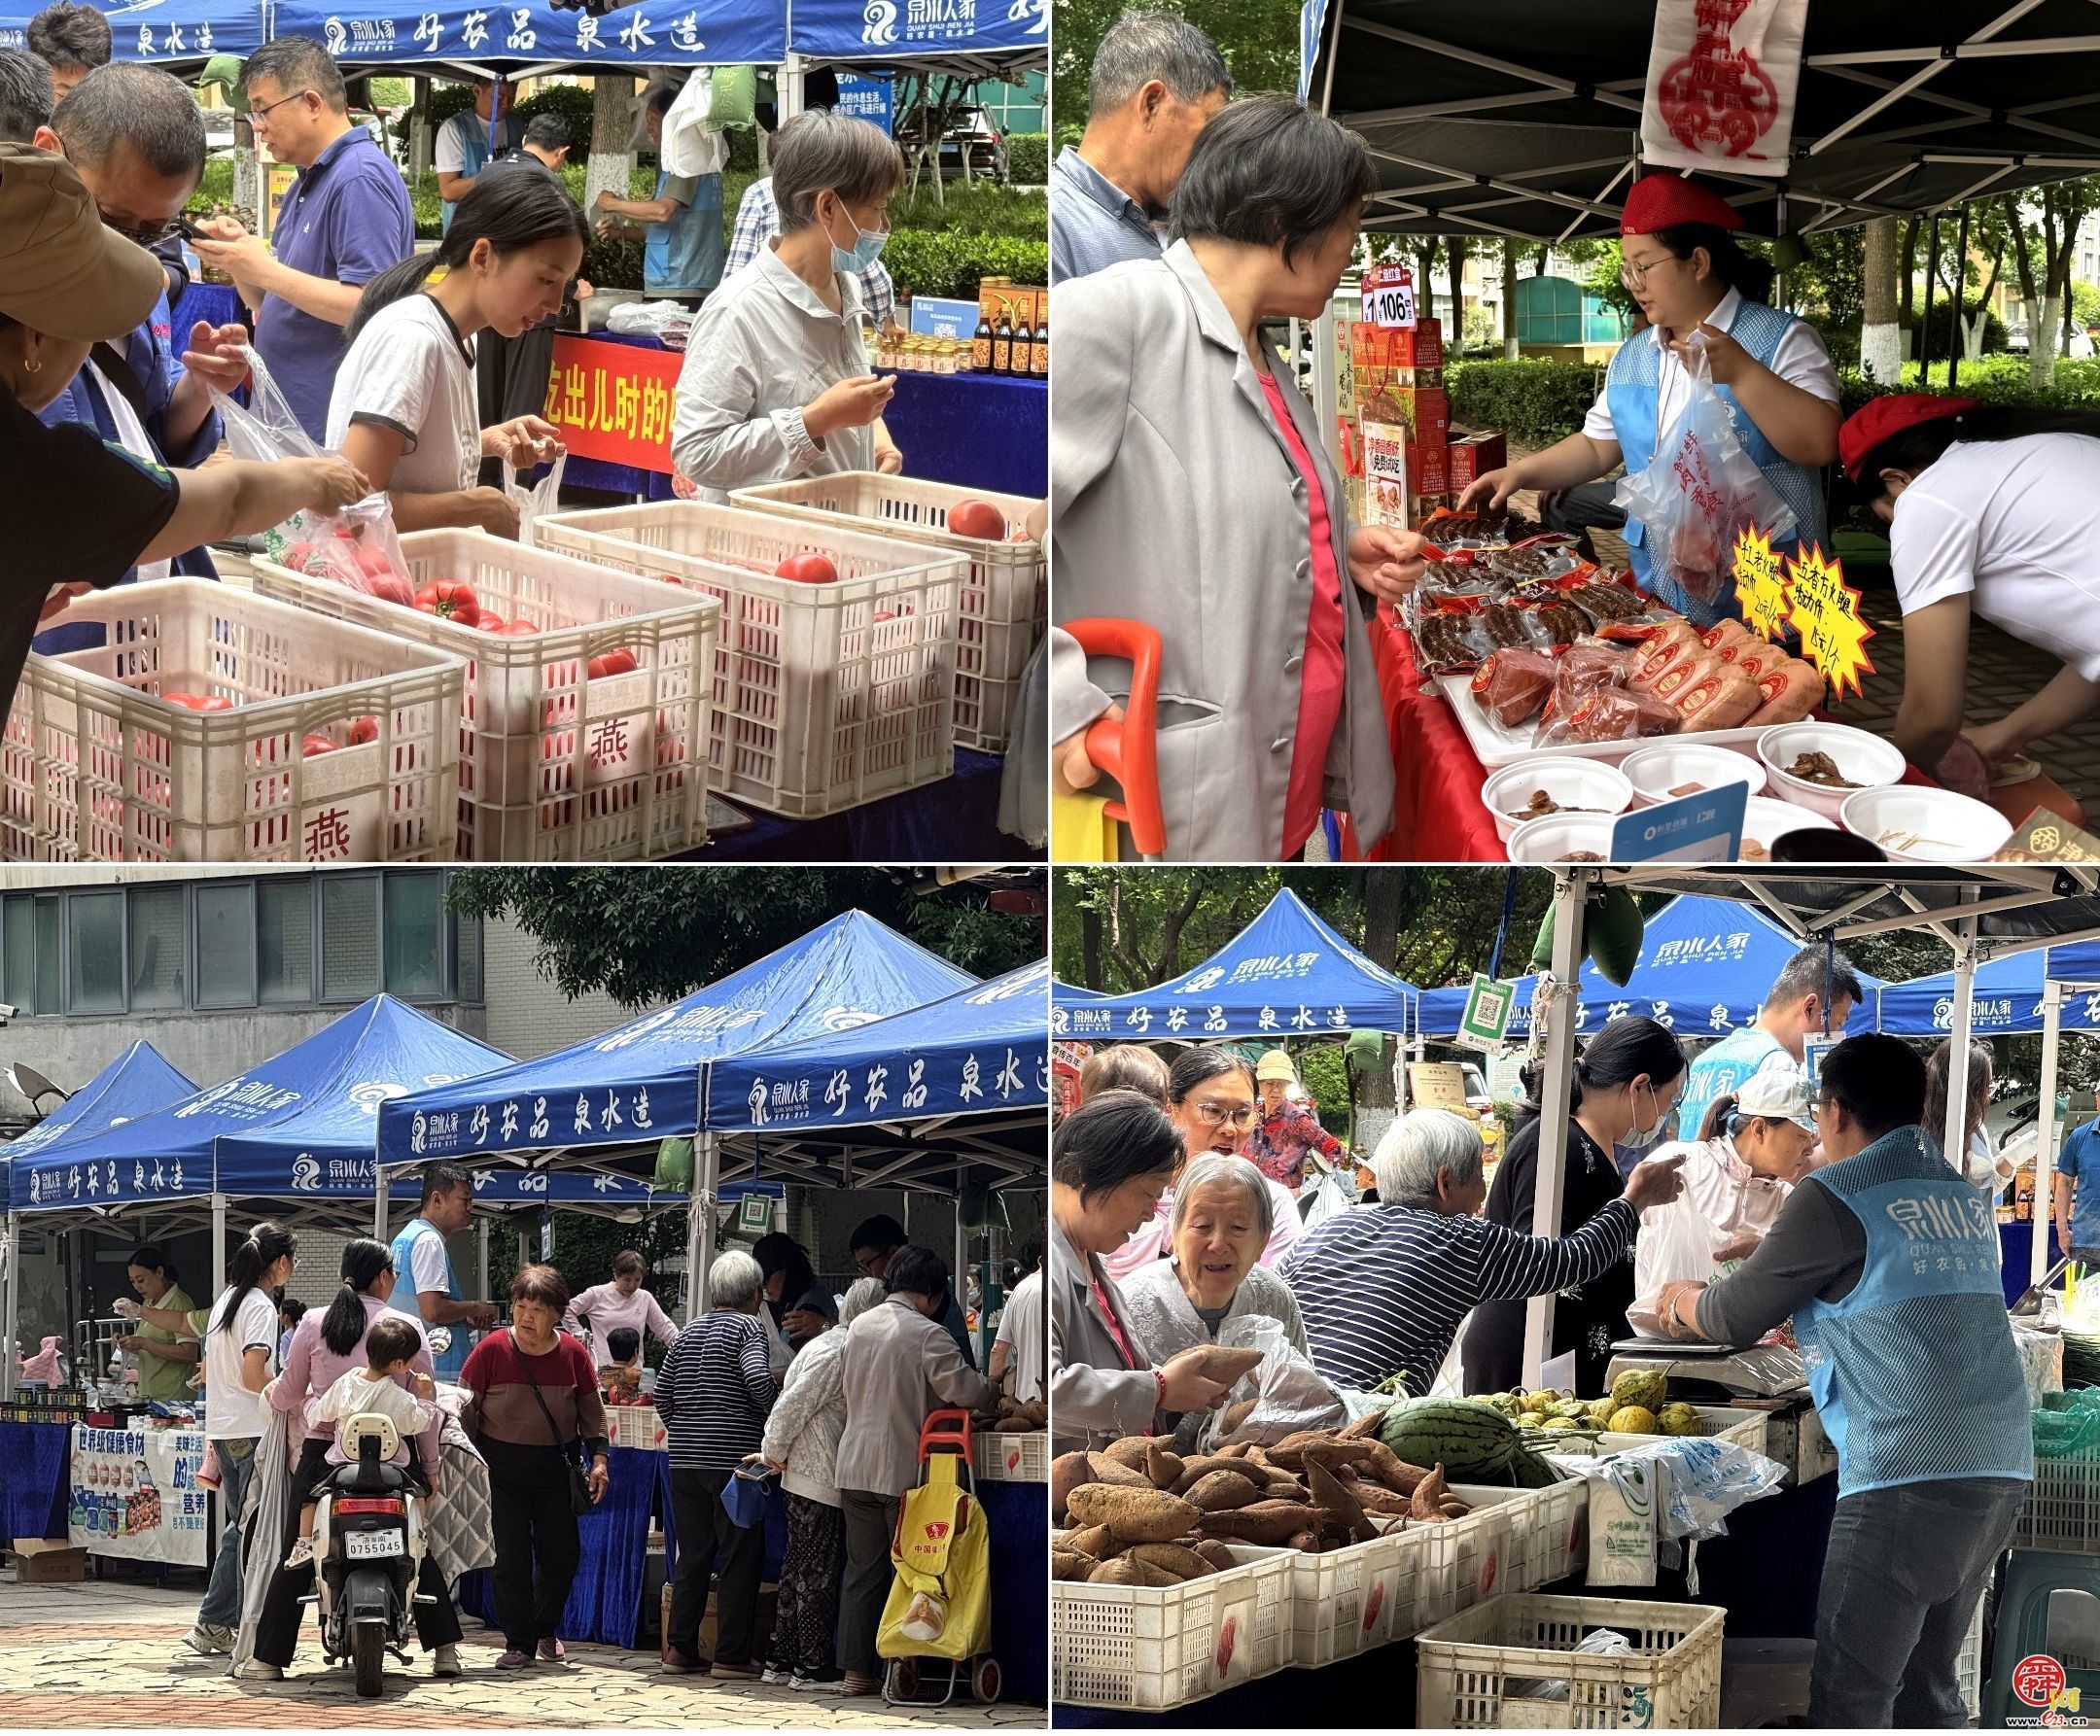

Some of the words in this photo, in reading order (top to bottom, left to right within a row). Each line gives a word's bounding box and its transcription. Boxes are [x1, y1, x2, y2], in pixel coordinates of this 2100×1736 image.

[137, 20, 218, 56] 泉水造
[413, 8, 537, 52] 好农品
[577, 11, 706, 52] 泉水造
[589, 718, 629, 771] 燕
[304, 808, 350, 862] 燕
[1127, 1005, 1228, 1032] 好农品
[1258, 1004, 1352, 1031] 泉水造
[823, 1059, 928, 1117] 好农品
[470, 1095, 549, 1146] 好农品
[575, 1086, 653, 1135] 泉水造
[67, 1160, 120, 1198] 好农品
[133, 1157, 184, 1194] 泉水造
[1886, 1195, 1995, 1241] 泉水人家
[173, 1457, 188, 1489] 的
[350, 1541, 401, 1554] 0755045
